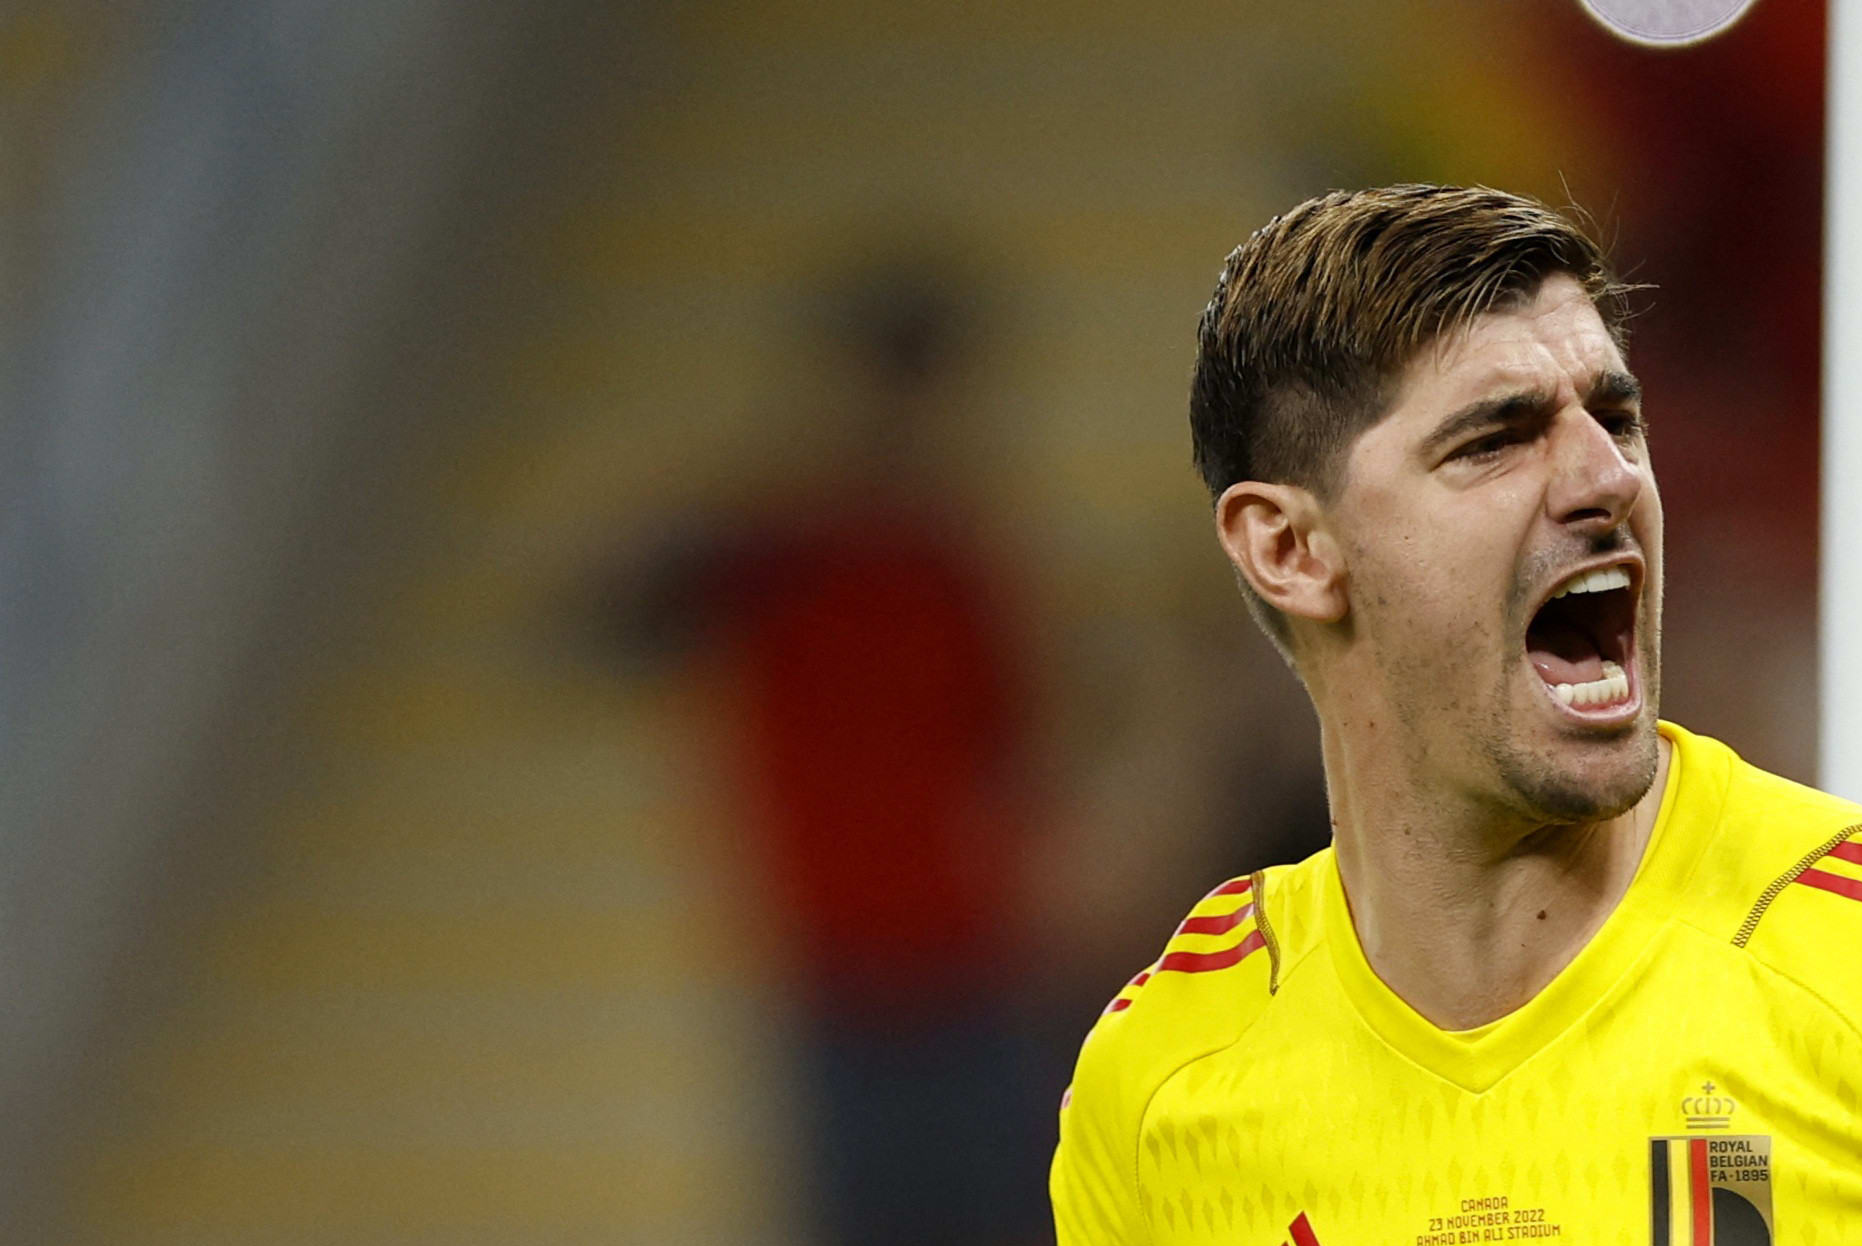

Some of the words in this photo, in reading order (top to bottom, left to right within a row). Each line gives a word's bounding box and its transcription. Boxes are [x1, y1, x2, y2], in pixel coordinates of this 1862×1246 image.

[1709, 1141, 1753, 1154] ROYAL
[1710, 1155, 1768, 1168] BELGIAN
[1461, 1196, 1508, 1212] CANADA
[1429, 1217, 1443, 1232] 23
[1447, 1212, 1510, 1229] NOVEMBER
[1514, 1208, 1545, 1224] 2022
[1459, 1229, 1480, 1244] BIN
[1483, 1227, 1504, 1242] ALI
[1507, 1223, 1561, 1240] STADIUM
